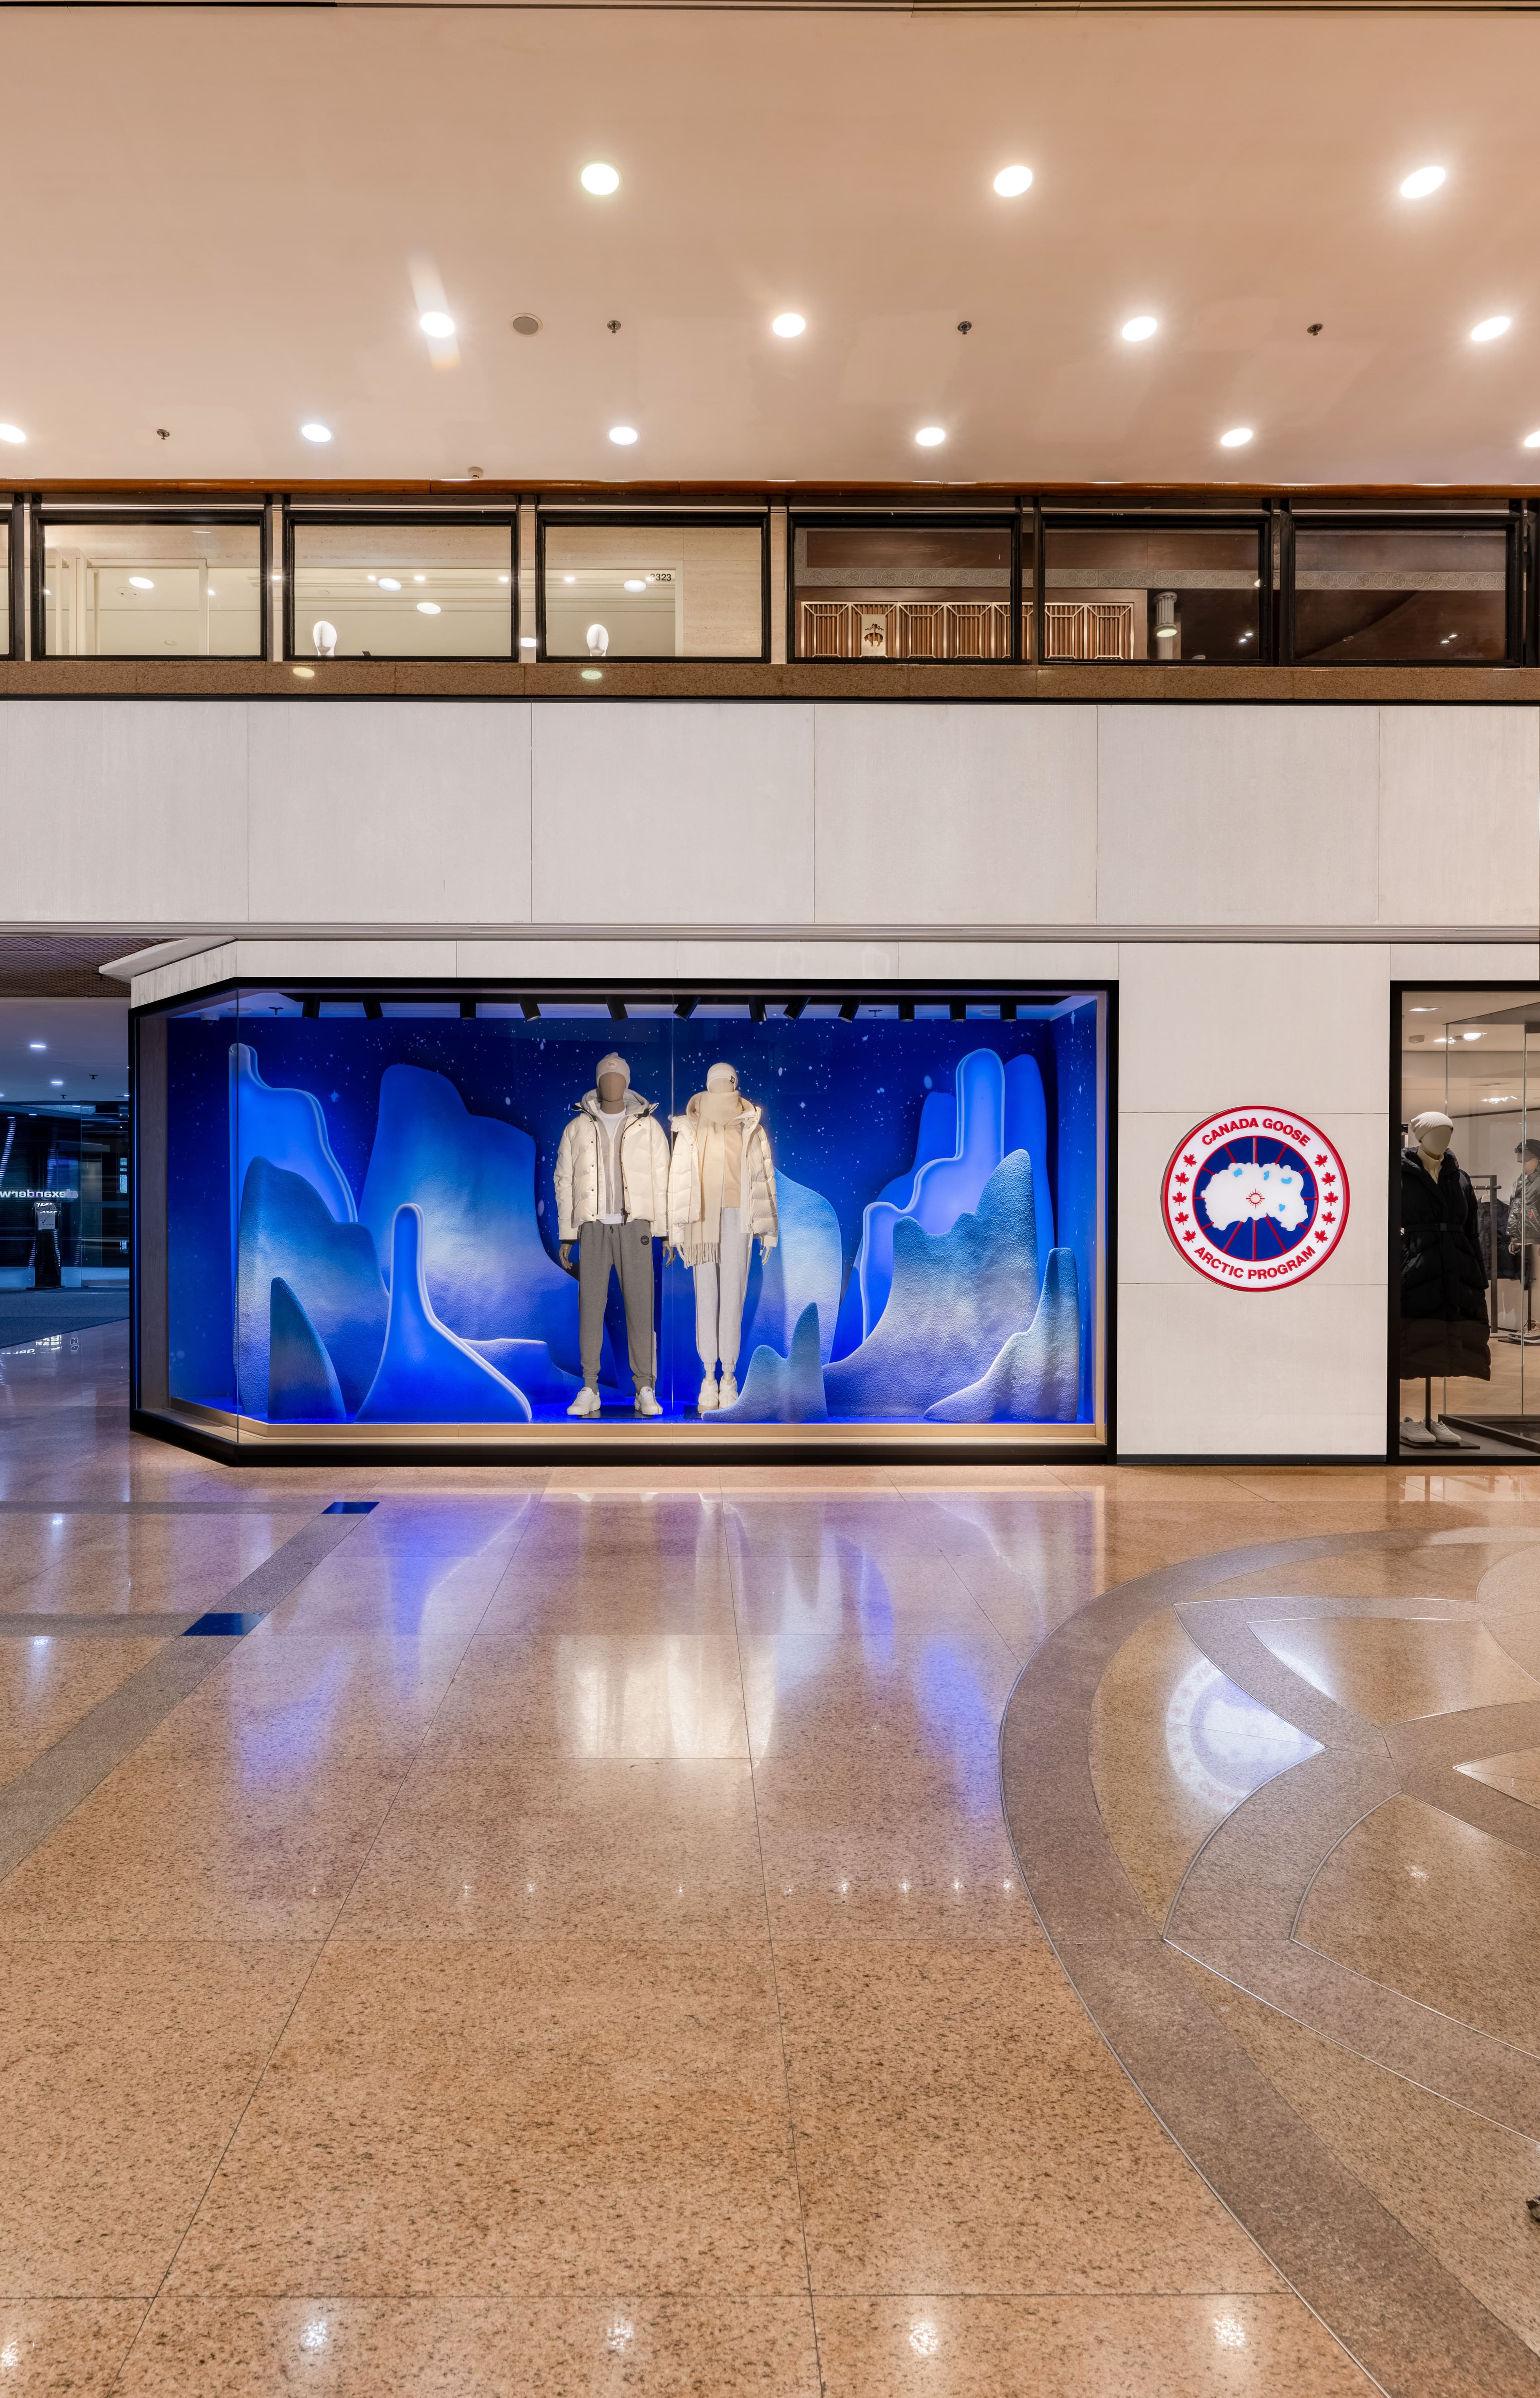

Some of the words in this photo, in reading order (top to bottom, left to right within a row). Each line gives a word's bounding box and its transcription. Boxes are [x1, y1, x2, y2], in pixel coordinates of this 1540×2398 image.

[1202, 1118, 1259, 1146] CANADA
[1262, 1118, 1311, 1147] GOOSE
[1194, 1247, 1244, 1278] ARCTIC
[1247, 1245, 1316, 1280] PROGRAM
